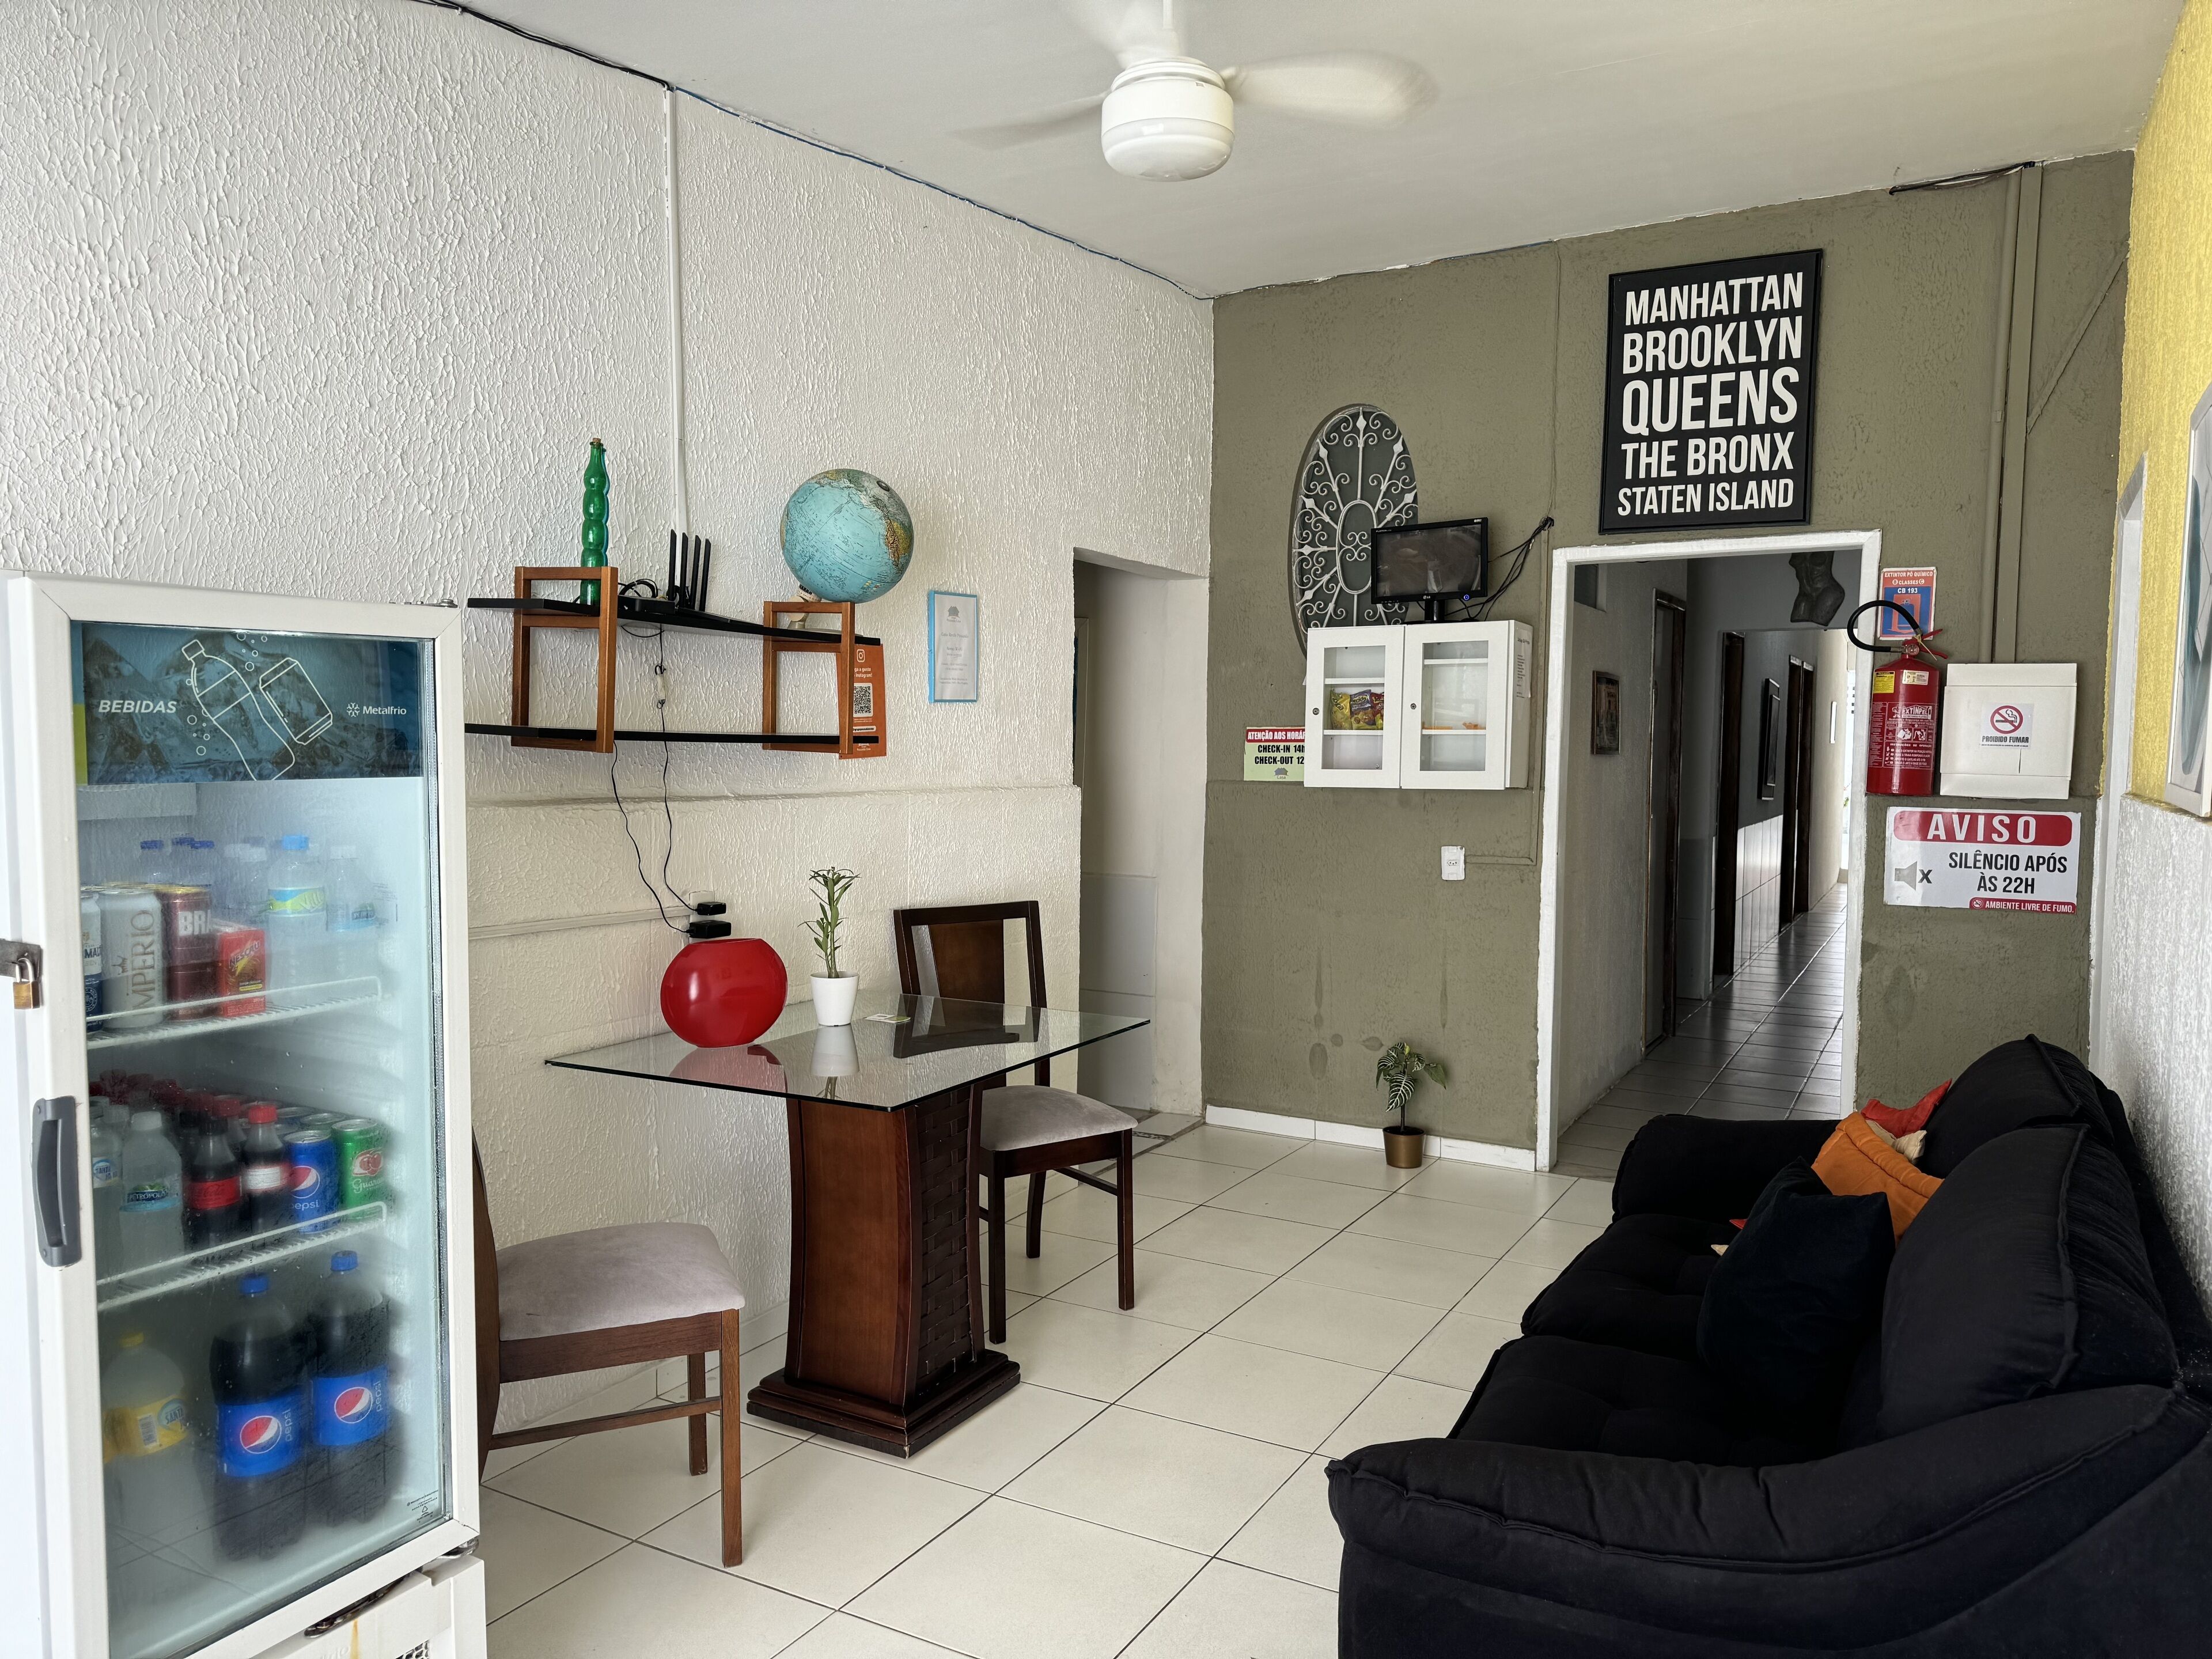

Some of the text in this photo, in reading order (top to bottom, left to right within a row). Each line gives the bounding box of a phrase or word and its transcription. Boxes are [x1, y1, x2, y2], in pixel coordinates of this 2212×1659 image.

[1625, 272, 1803, 326] MANHATTAN
[1623, 316, 1802, 374] BROOKLYN
[1622, 366, 1800, 435] QUEENS
[1621, 431, 1794, 479] THE BRONX
[1618, 478, 1794, 516] STATEN ISLAND
[99, 700, 177, 713] BEBIDAS
[363, 706, 407, 715] Metalfrio
[1902, 706, 1928, 715] EXTINPEL
[1248, 730, 1273, 741] ATENÇÃO
[1274, 731, 1286, 740] AOS
[1257, 744, 1290, 753] CHECK-IN
[1255, 756, 1304, 764] CHECK-OUT 12
[1927, 813, 2036, 843] AVISO
[1948, 850, 2067, 873] SILÊNCIO APÓS
[1977, 872, 2035, 894] ÀS 22H
[1985, 901, 2074, 913] AMBIENTE LIVRE DE FUMO.
[373, 1381, 383, 1412] pepsi
